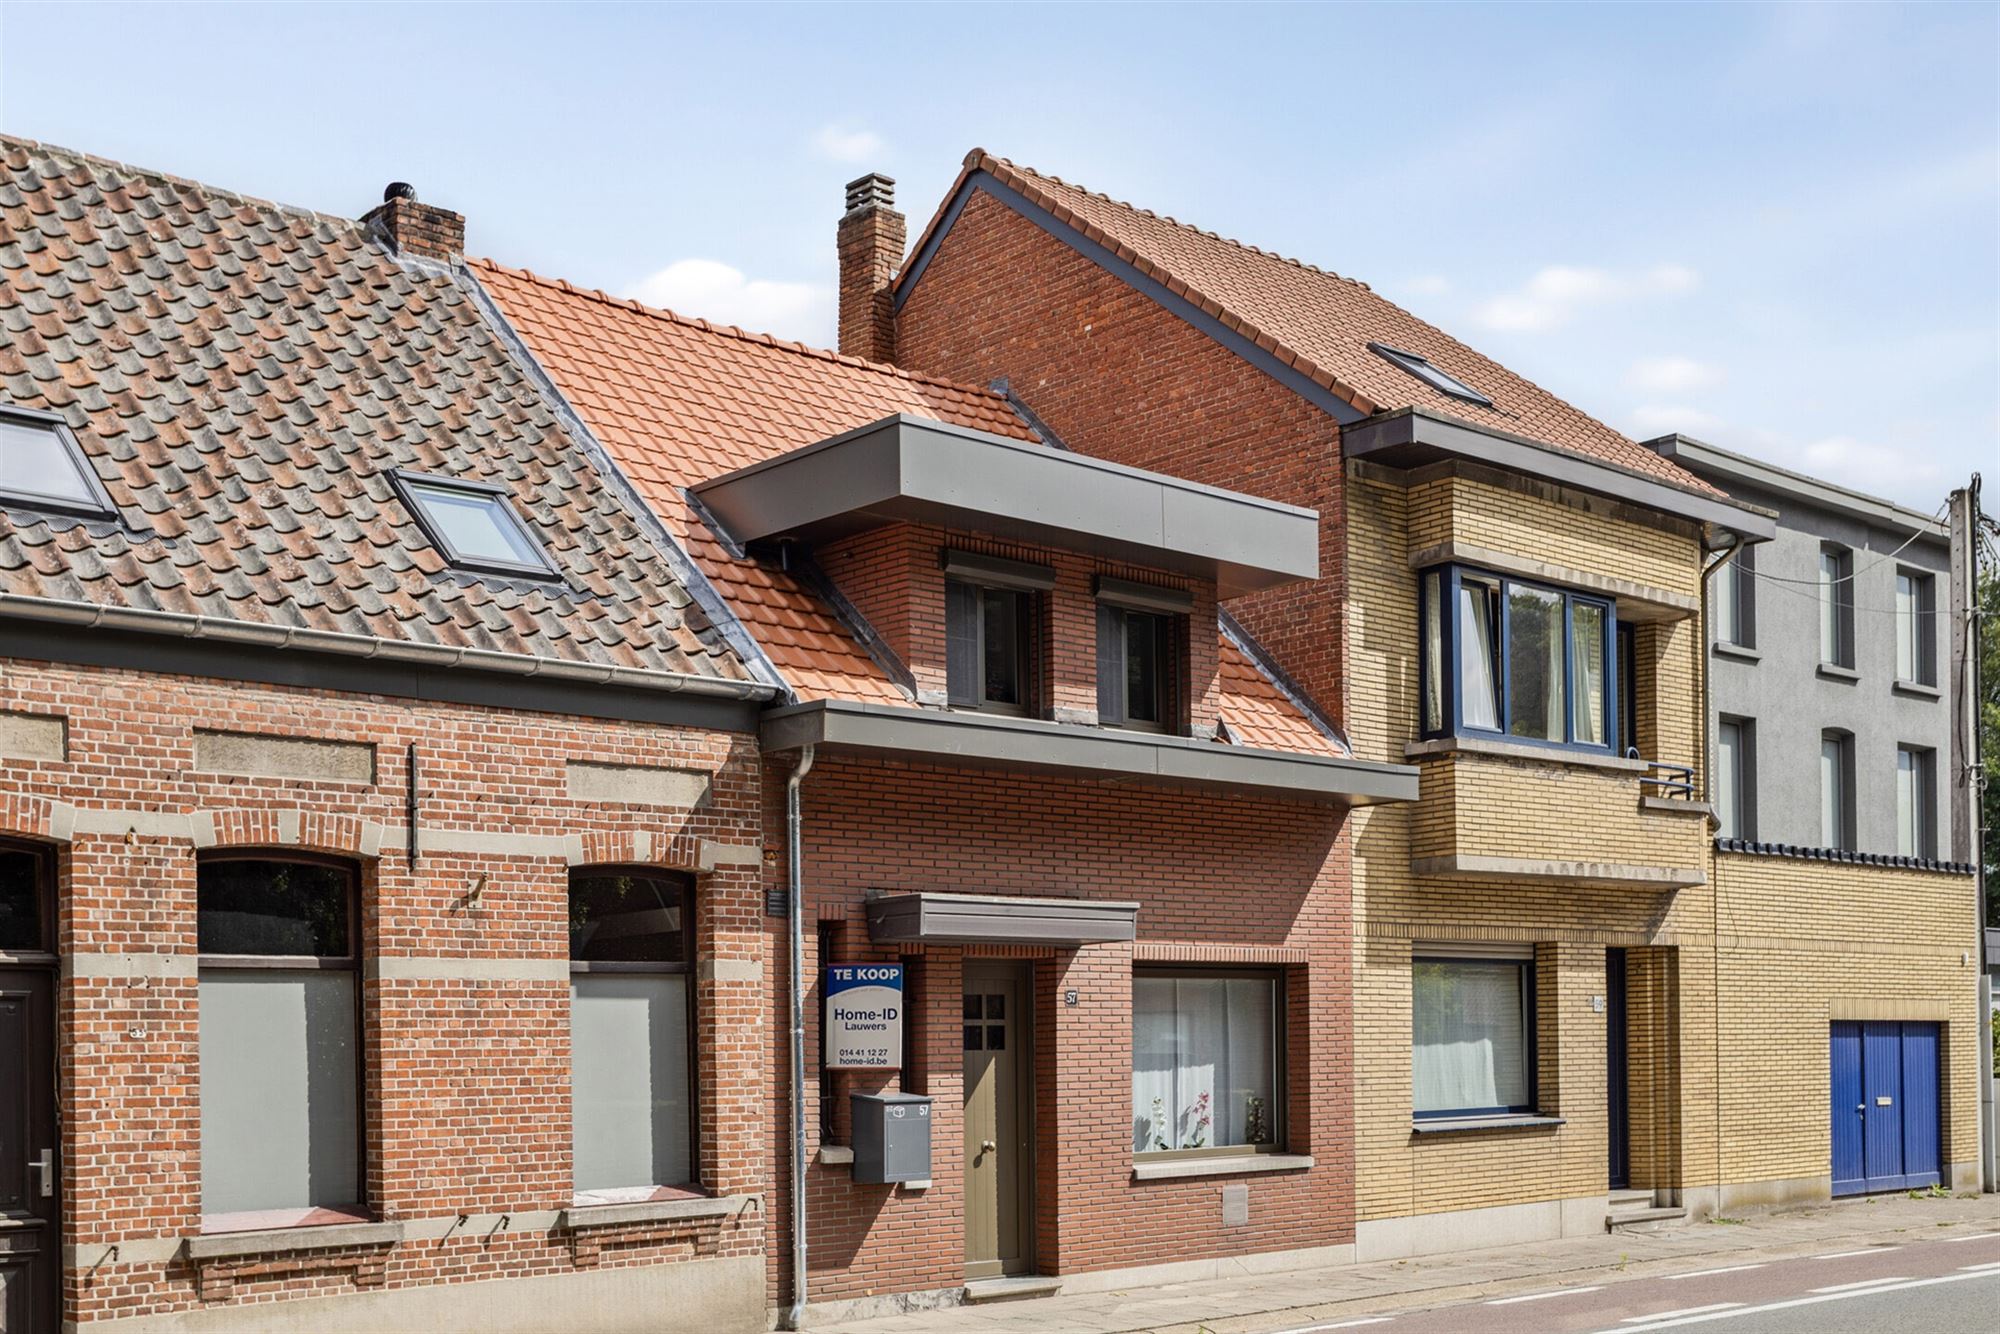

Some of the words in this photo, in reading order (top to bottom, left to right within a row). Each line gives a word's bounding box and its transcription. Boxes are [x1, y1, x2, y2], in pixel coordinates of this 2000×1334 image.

[833, 968, 853, 980] TE
[857, 968, 900, 980] KOOP
[1067, 992, 1077, 1004] 57
[834, 1007, 898, 1021] Home-ID
[845, 1022, 887, 1031] Lauwers
[839, 1057, 888, 1065] home-id.be
[919, 1105, 929, 1116] 57
